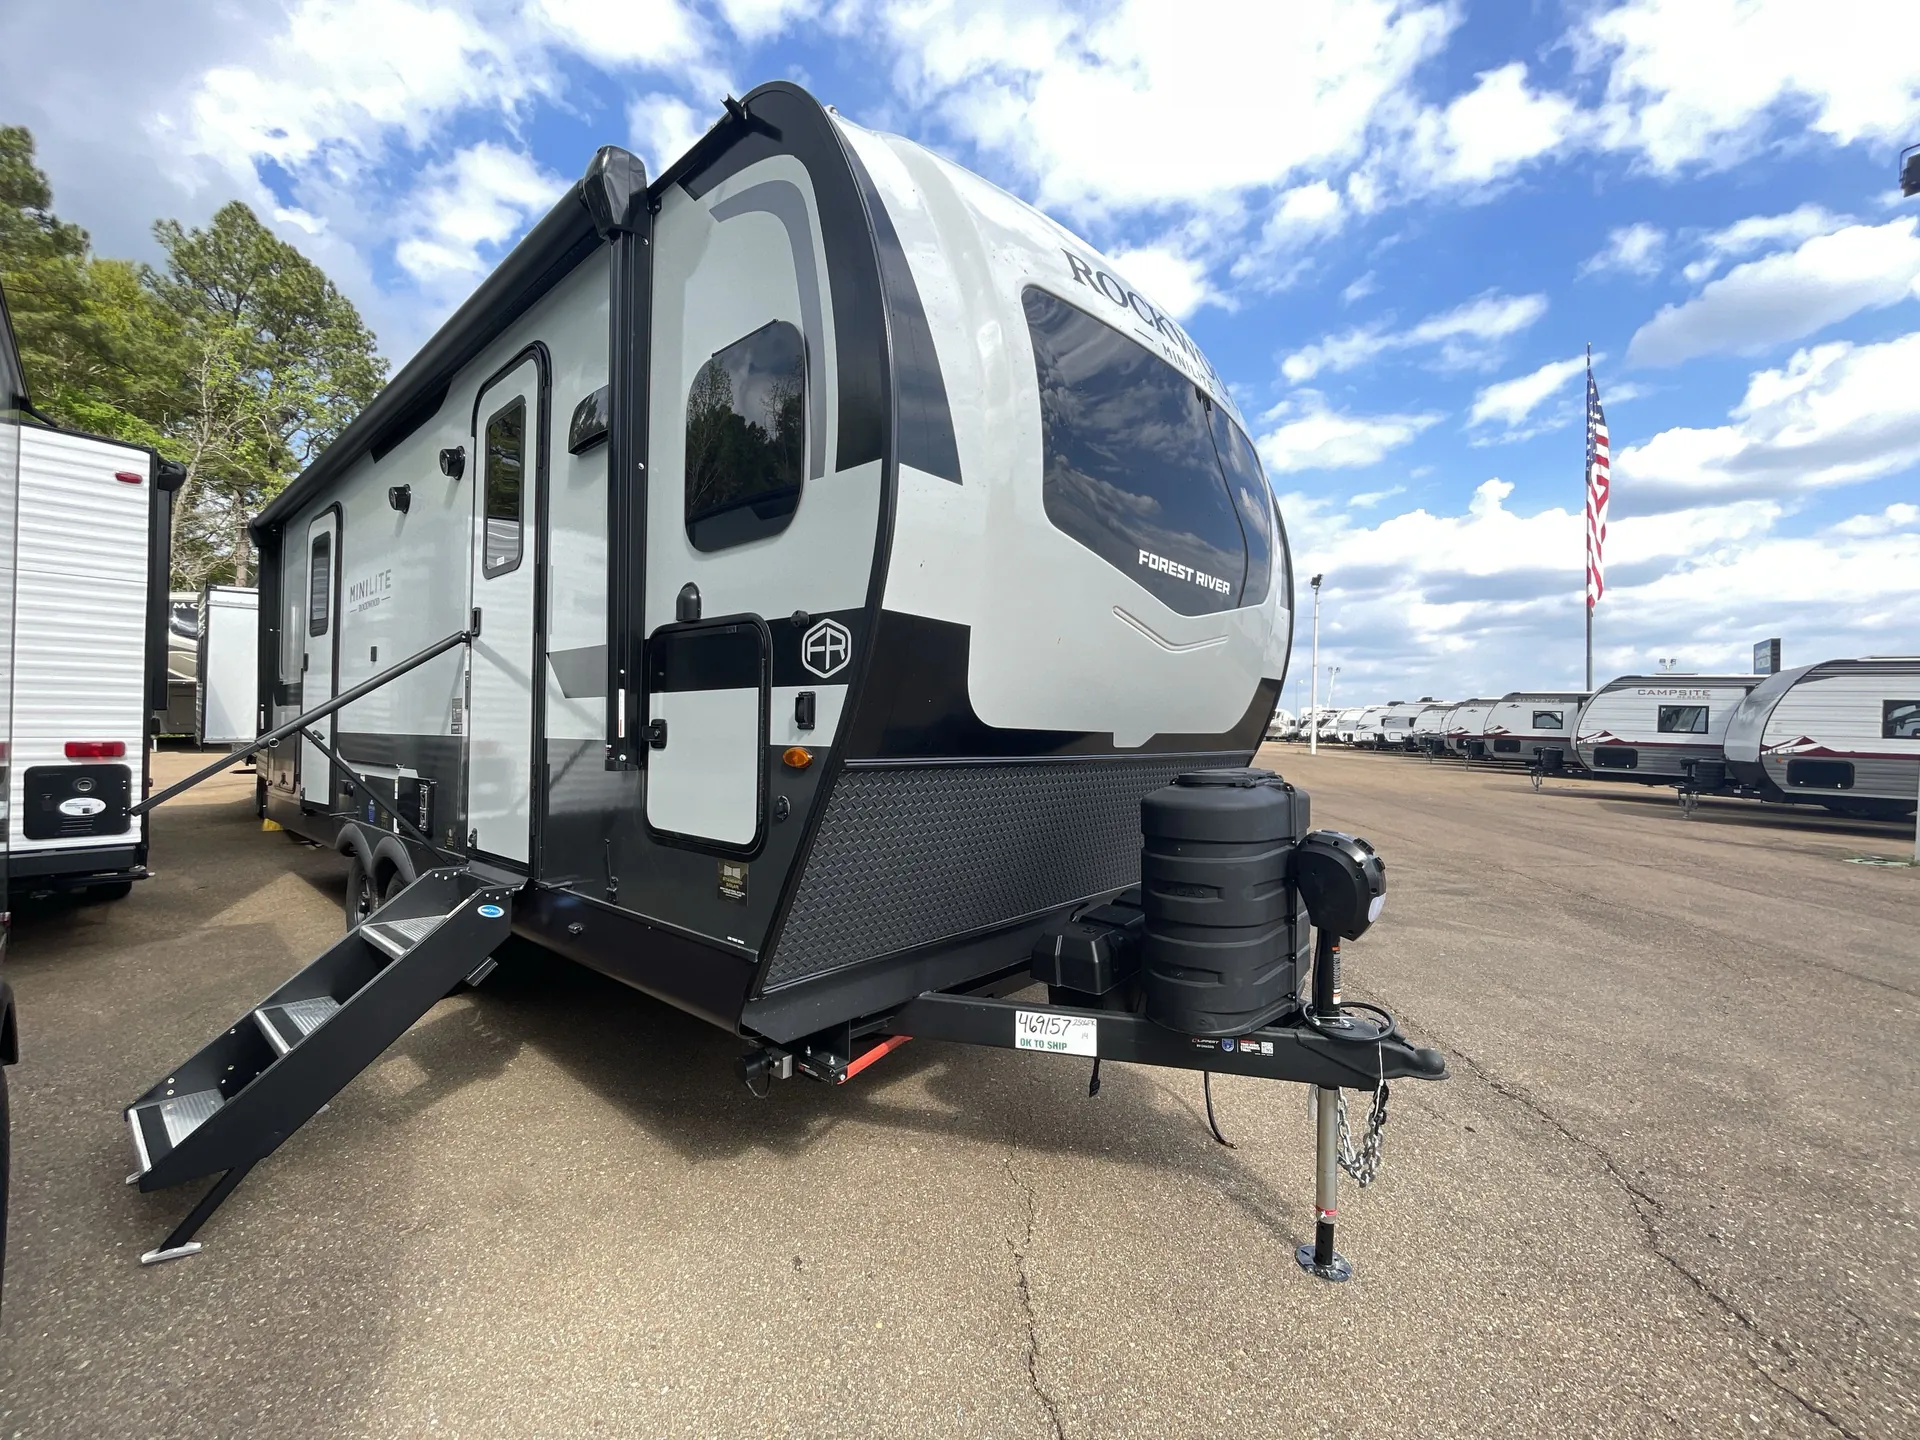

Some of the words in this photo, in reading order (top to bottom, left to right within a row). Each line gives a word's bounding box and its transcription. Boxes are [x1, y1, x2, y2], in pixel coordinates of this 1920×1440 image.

[1162, 342, 1215, 395] MINILITE
[349, 568, 392, 604] MINILITE
[1138, 548, 1195, 582] FOREST
[1195, 570, 1231, 595] RIVER
[1018, 1012, 1072, 1036] 469157
[1020, 1037, 1033, 1047] OK
[1034, 1039, 1045, 1049] TO
[1046, 1040, 1068, 1051] SHIP
